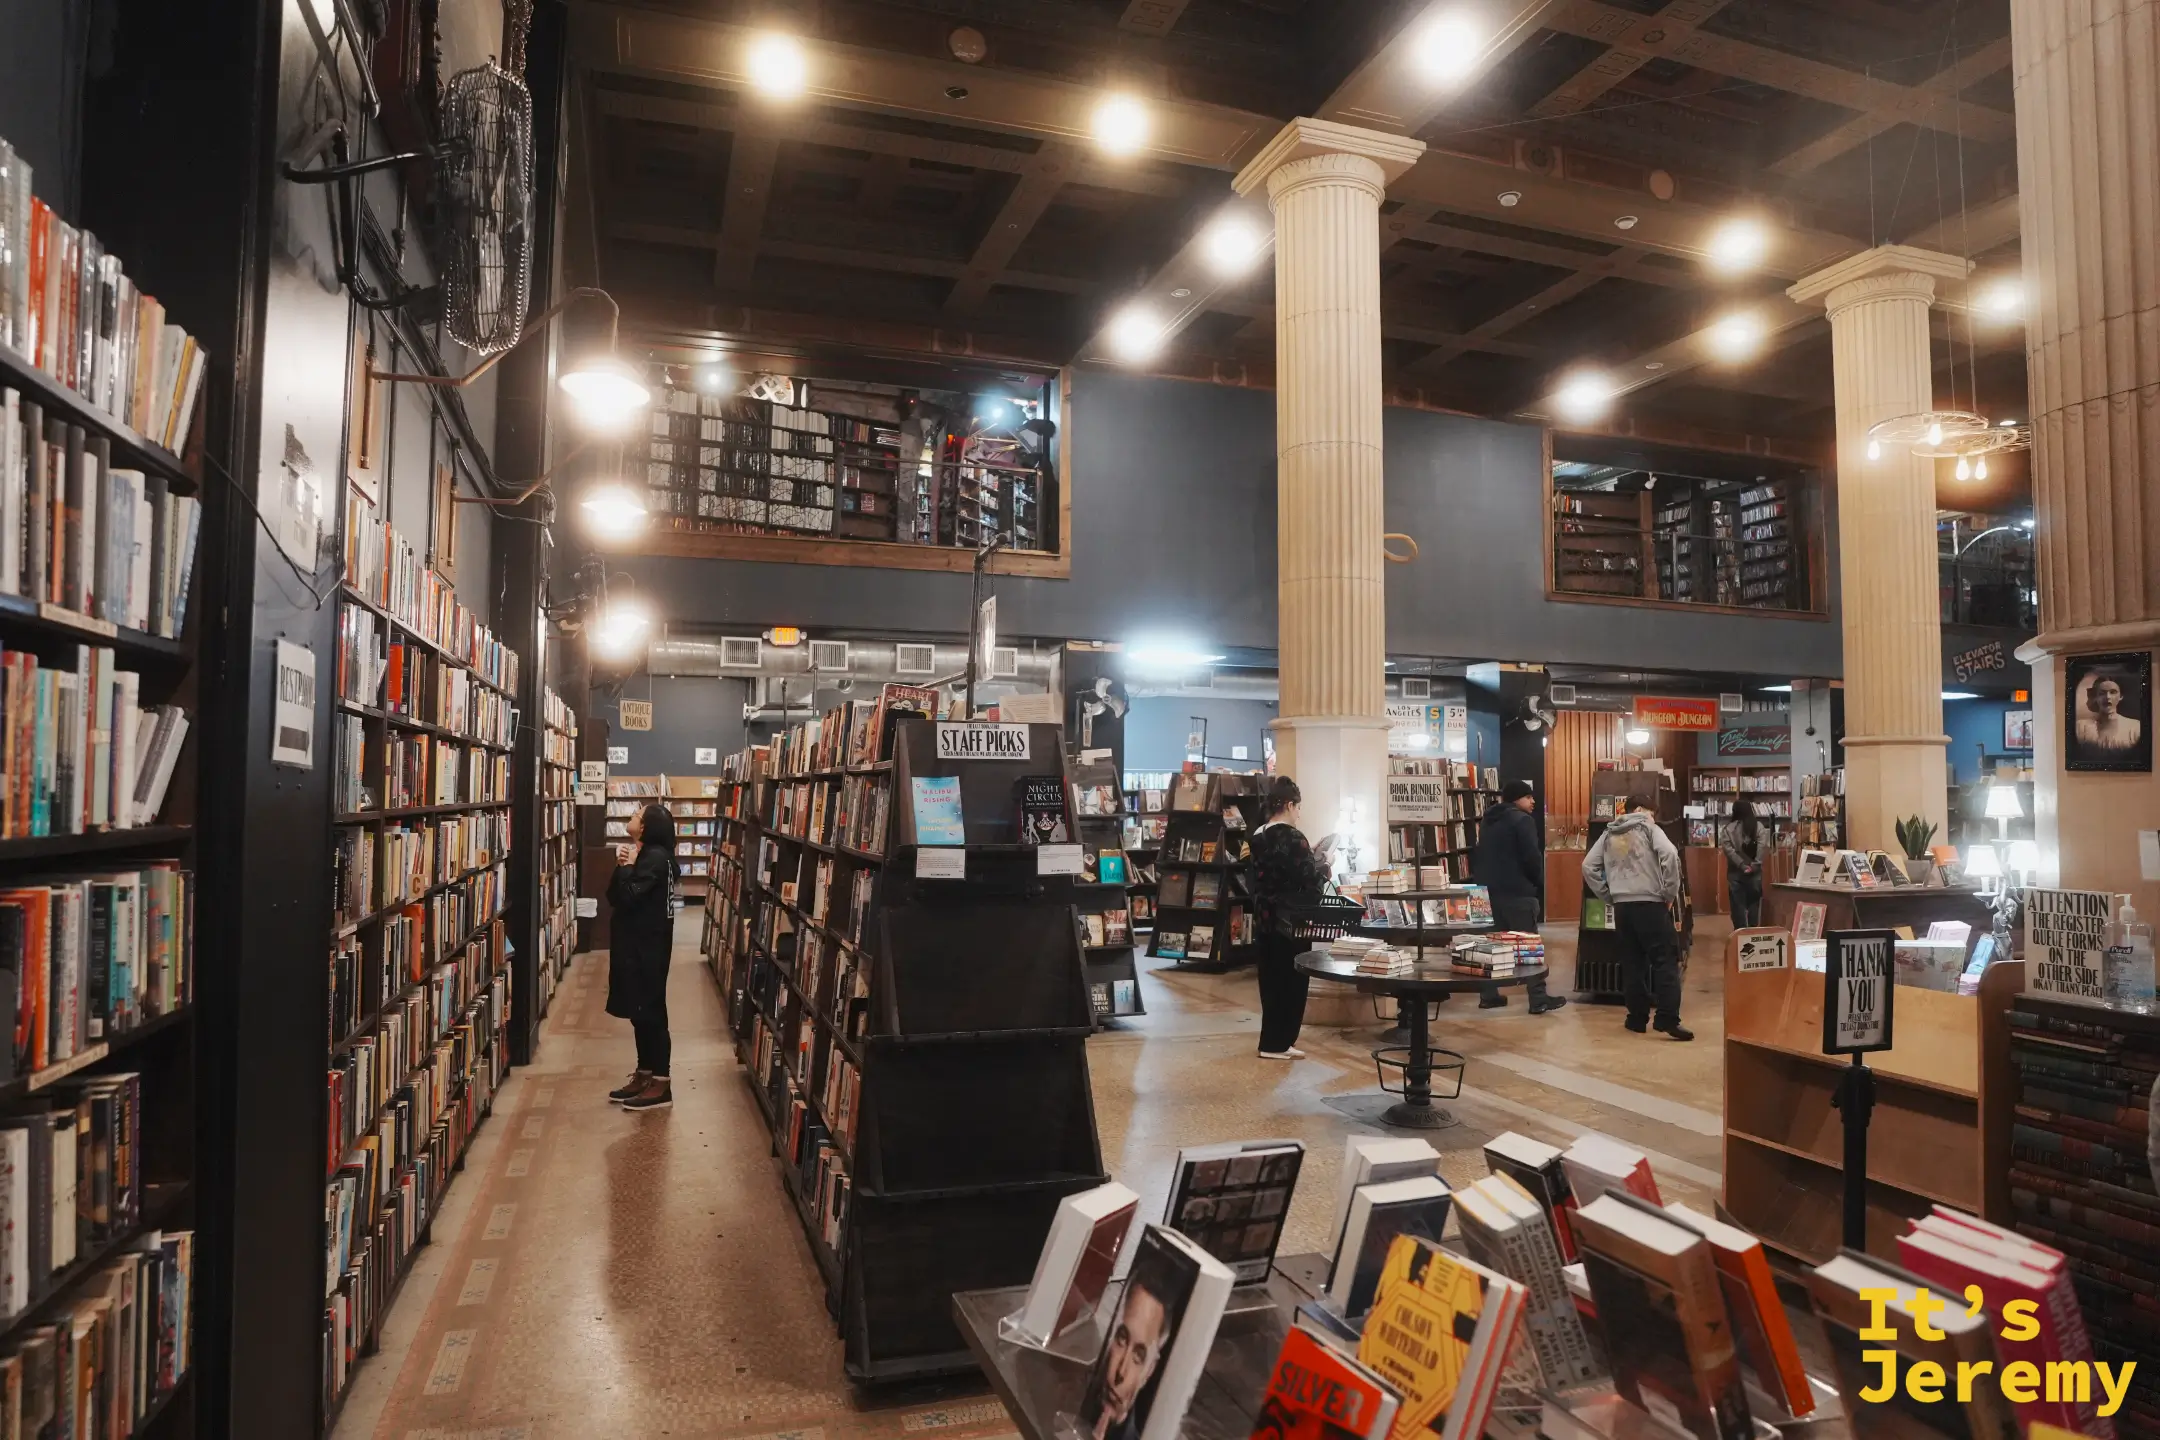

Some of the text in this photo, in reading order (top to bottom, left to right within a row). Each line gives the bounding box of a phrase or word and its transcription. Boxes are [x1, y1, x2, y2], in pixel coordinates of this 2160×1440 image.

[1952, 641, 2002, 666] ELEVATOR
[1956, 651, 2005, 683] STAIRS
[895, 688, 932, 699] HEART
[622, 702, 651, 715] ANTIQUE
[1386, 706, 1422, 717] ANGELES
[625, 715, 648, 728] BOOKS
[1641, 710, 1712, 727] DUNGEON DUNGEON
[941, 729, 1025, 752] STAFF PICKS
[1730, 734, 1790, 753] Yourself
[1026, 793, 1063, 802] CIRCUS
[1028, 785, 1060, 793] NIGHT
[1390, 783, 1441, 796] BOOK BUNDLES
[1392, 794, 1404, 802] FROM
[412, 876, 421, 894] C
[2027, 890, 2109, 917] ATTENTION
[2031, 912, 2105, 935] THE REGISTER
[2033, 929, 2104, 952] QUEUE FORMS
[1840, 942, 1886, 978] THANK
[2049, 947, 2087, 968] ON THE
[2038, 963, 2099, 987] OTHER SIDE
[1847, 979, 1875, 1013] YOU
[2033, 978, 2053, 991] OKAY
[2055, 981, 2081, 996] THANX
[1274, 1360, 1365, 1427] SILVER
